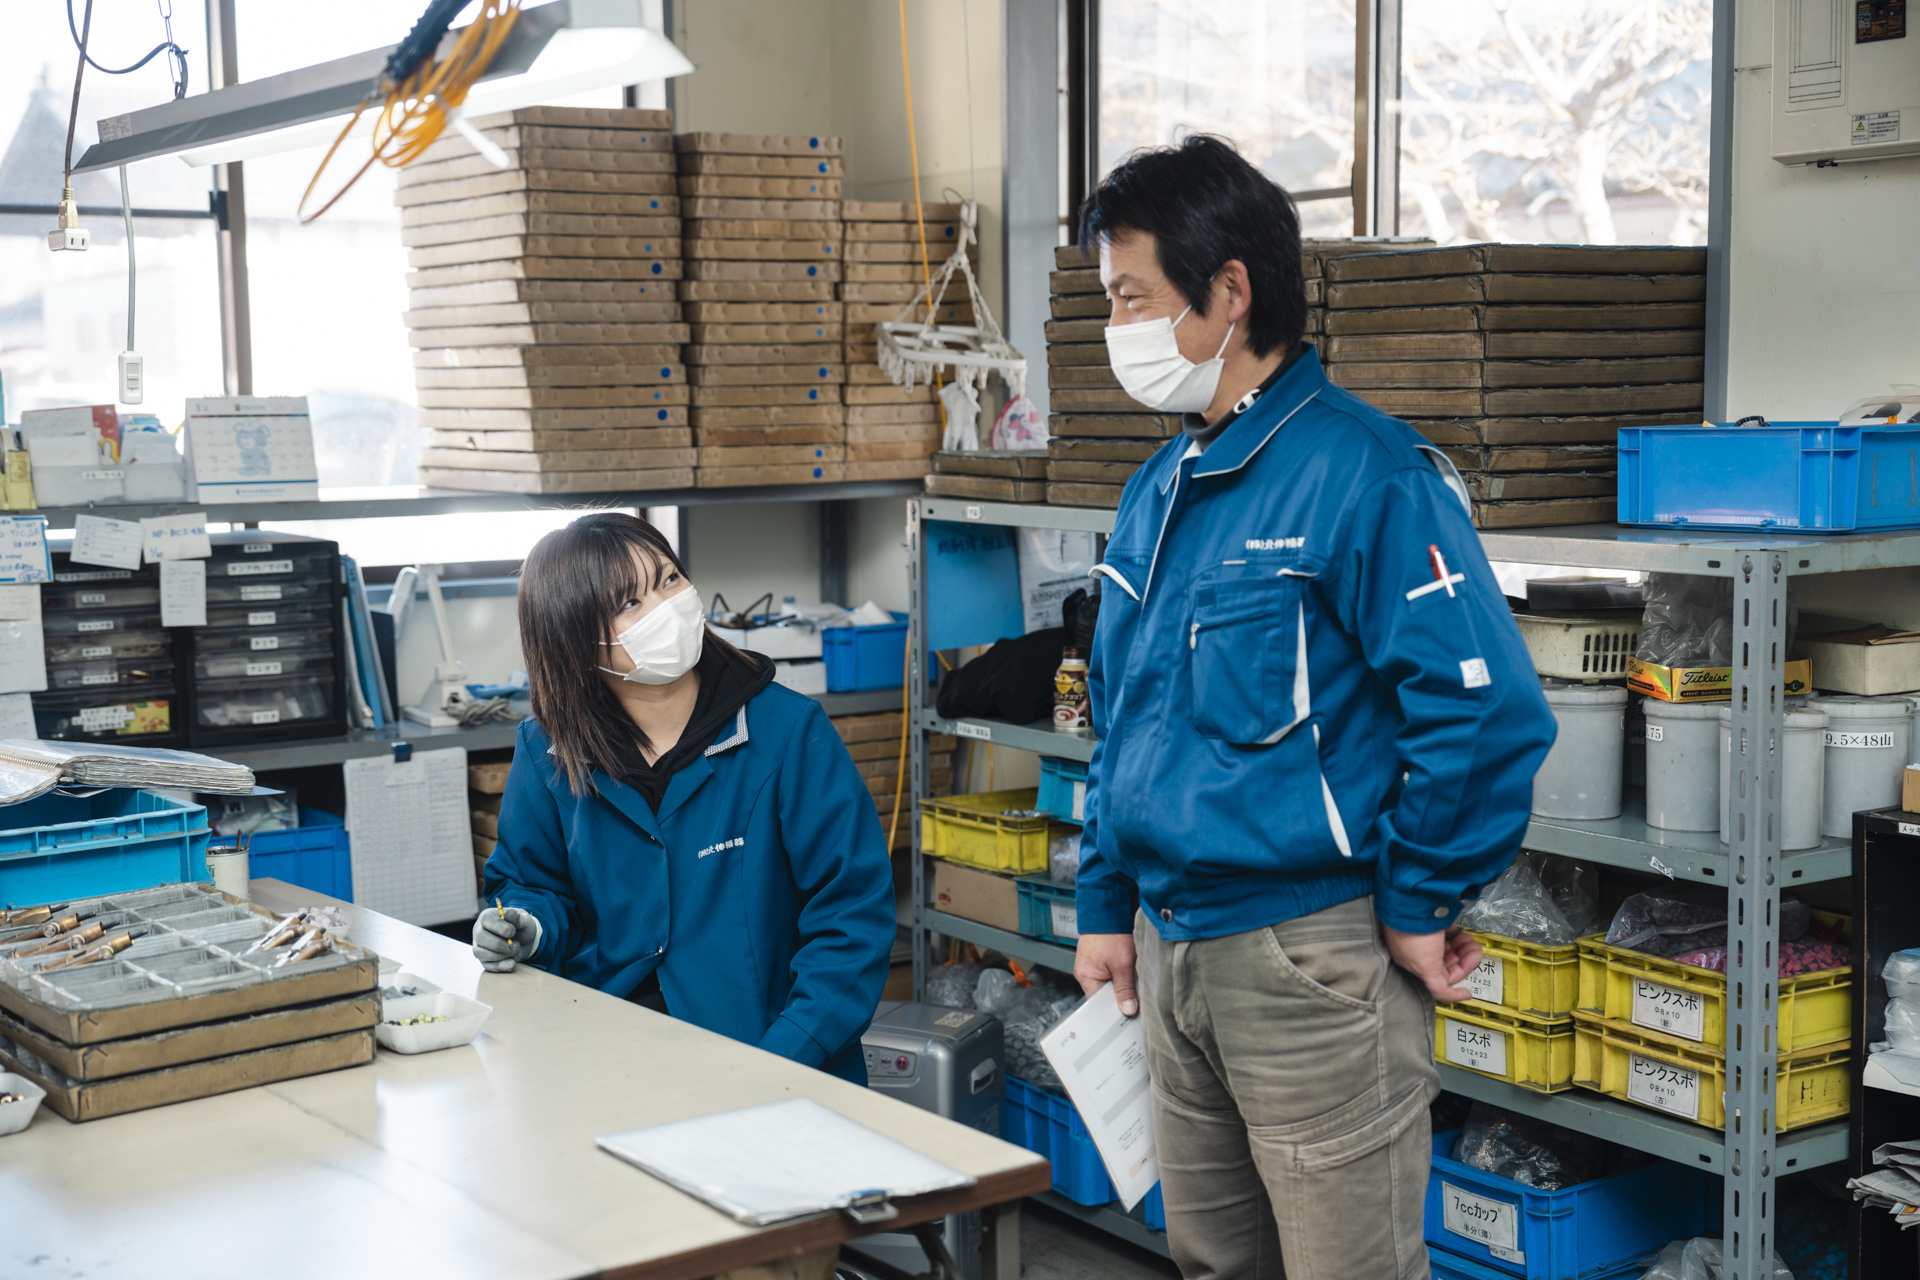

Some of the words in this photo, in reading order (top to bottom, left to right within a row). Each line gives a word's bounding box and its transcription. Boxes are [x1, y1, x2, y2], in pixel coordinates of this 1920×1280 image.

[1681, 671, 1730, 685] Titleist
[1638, 983, 1698, 1011] ピンクスポ
[1457, 1027, 1491, 1048] 白スポ
[1634, 1059, 1695, 1088] ピンクスポ
[1454, 1196, 1502, 1223] 7ccカップ
